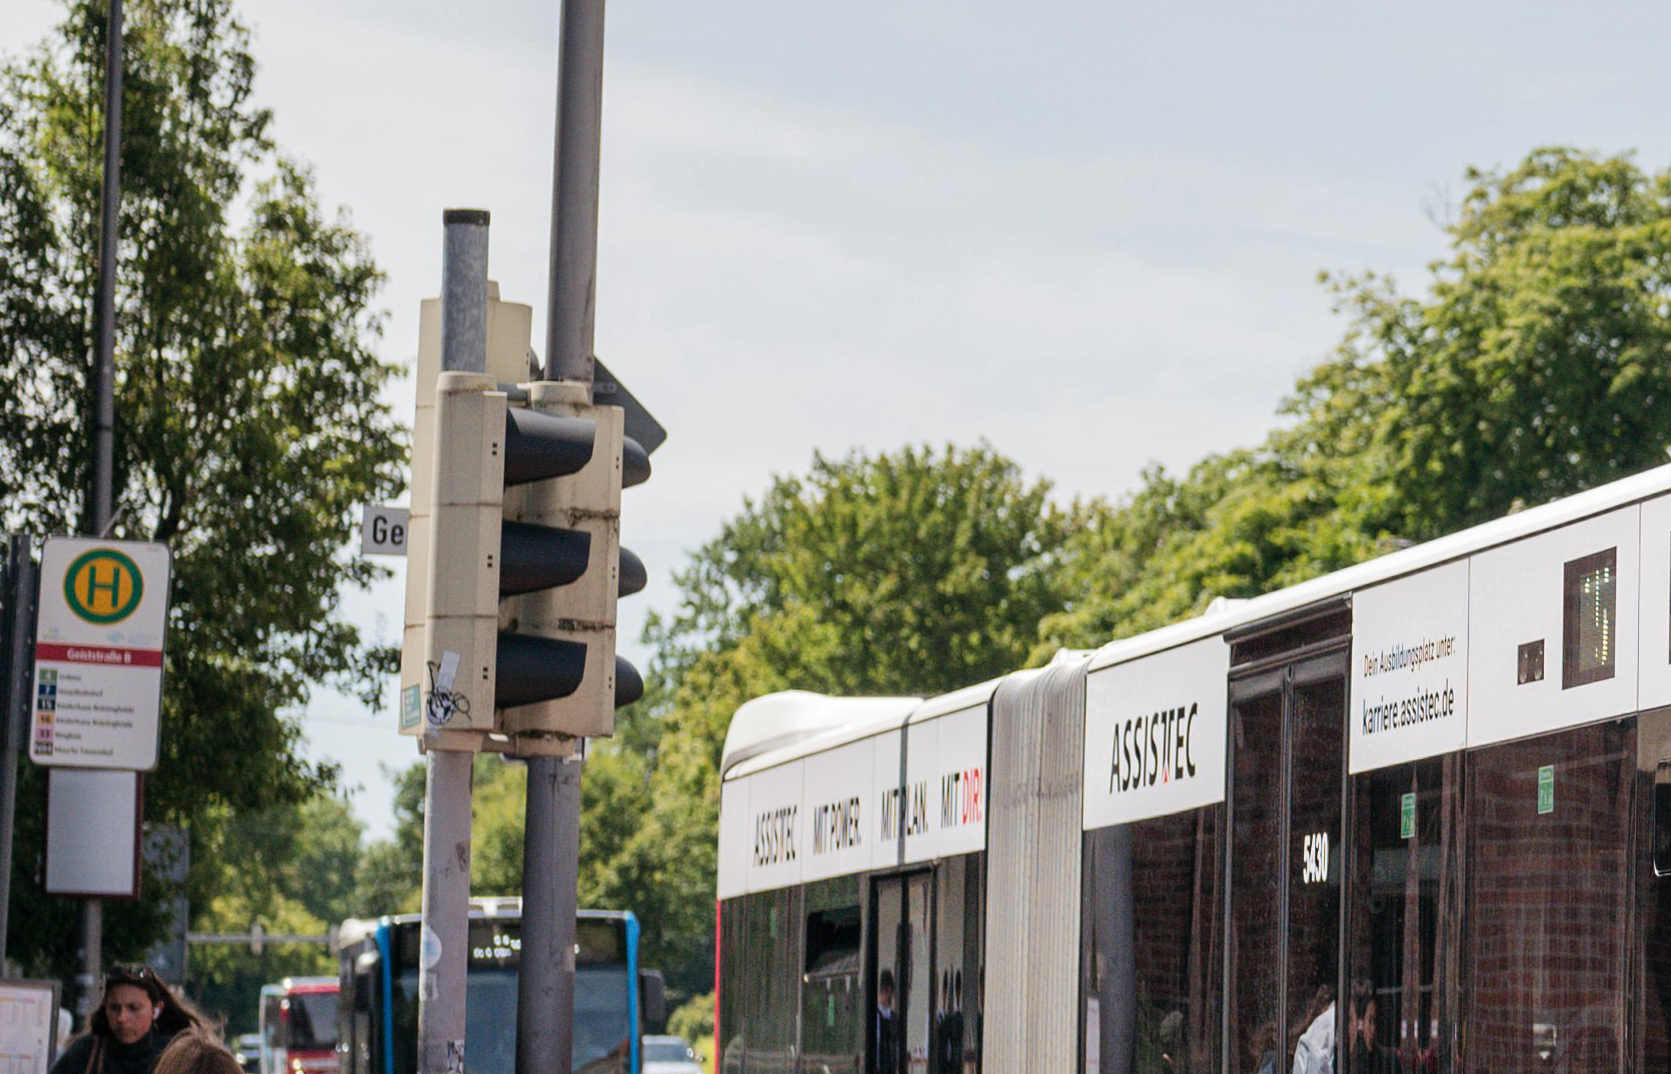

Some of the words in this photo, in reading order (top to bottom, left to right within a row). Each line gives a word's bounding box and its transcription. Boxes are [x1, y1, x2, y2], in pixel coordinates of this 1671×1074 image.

[1364, 650, 1378, 678] Dein
[1380, 636, 1434, 673] Ausbildungsplatz
[1436, 633, 1455, 658] unter:
[1362, 677, 1455, 736] karriere.assistec.de
[813, 804, 829, 855] MIT
[830, 795, 862, 851] POWER.
[880, 787, 899, 841] MIT
[940, 771, 960, 829] MIT
[962, 765, 983, 825] DIR!
[1303, 832, 1329, 884] 5430
